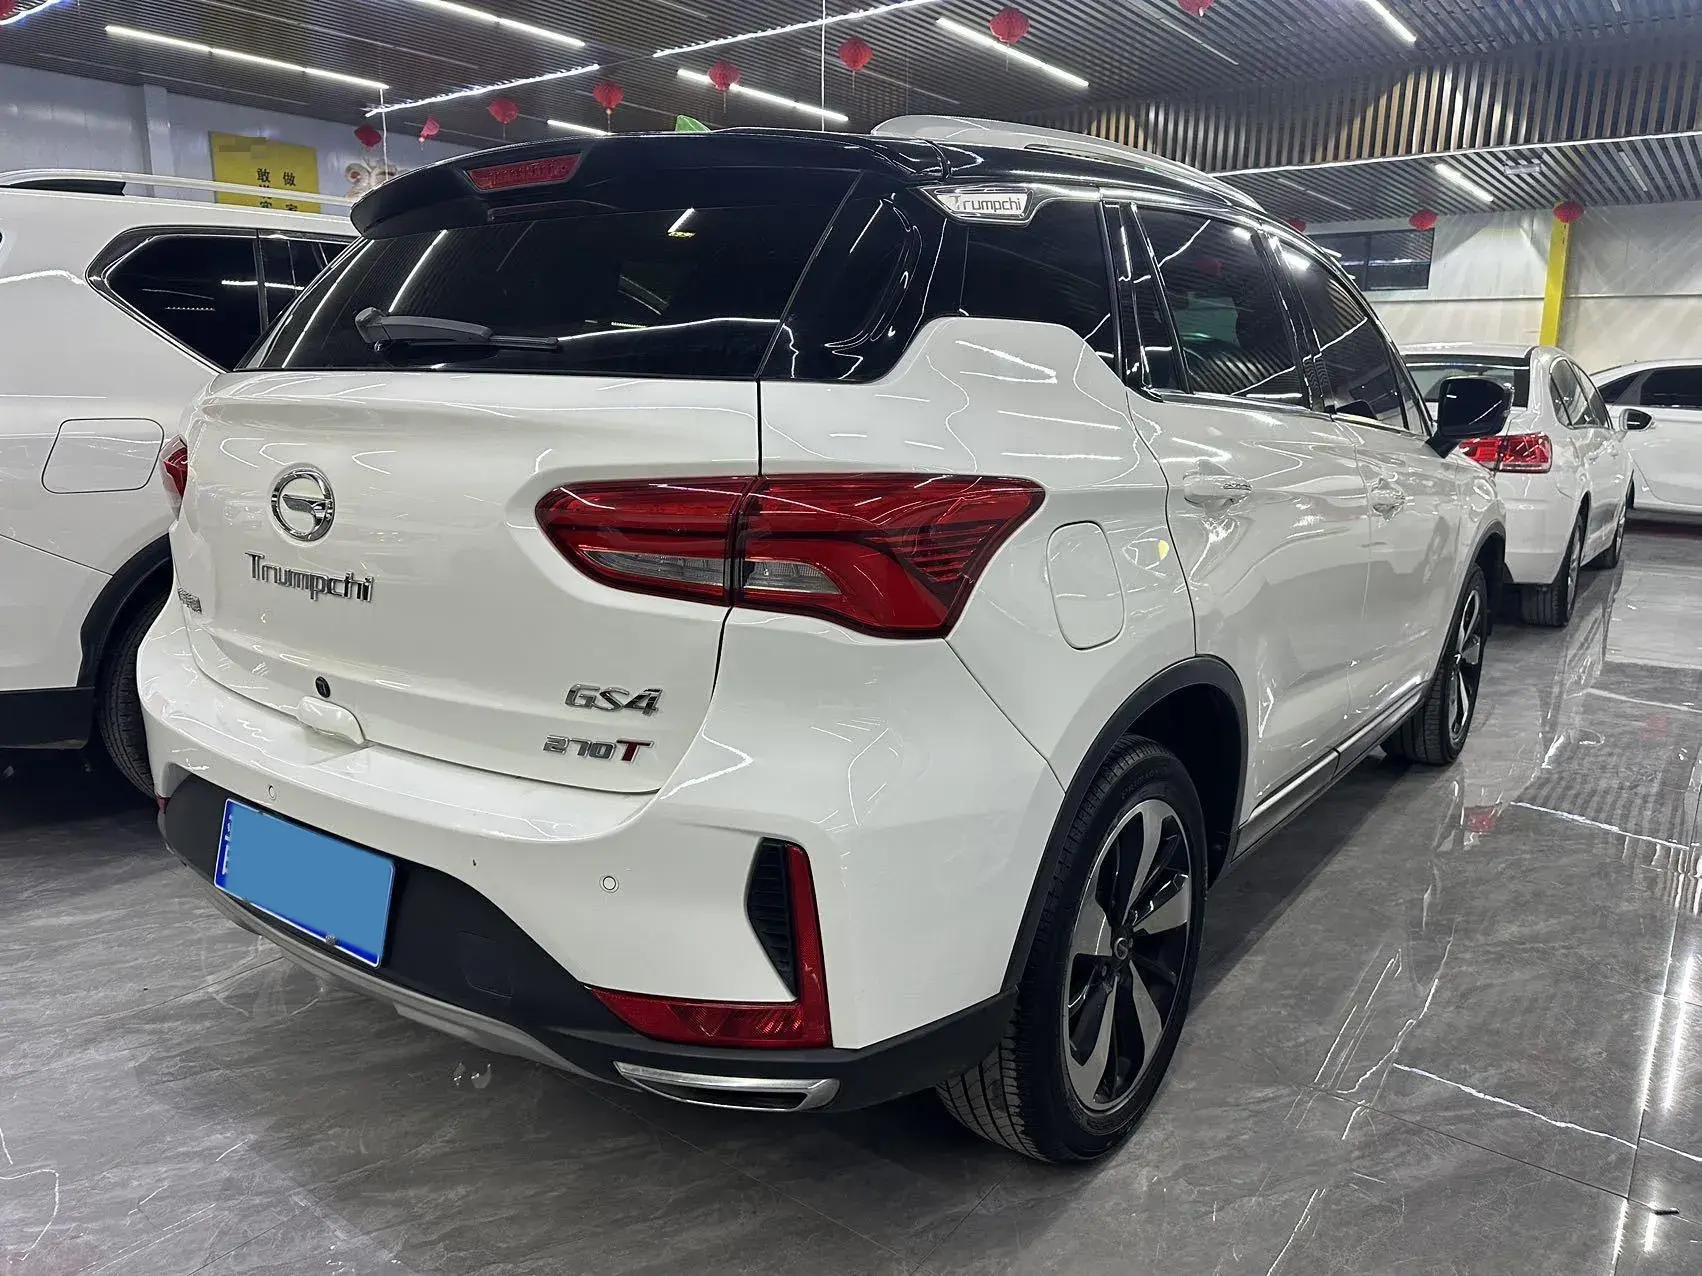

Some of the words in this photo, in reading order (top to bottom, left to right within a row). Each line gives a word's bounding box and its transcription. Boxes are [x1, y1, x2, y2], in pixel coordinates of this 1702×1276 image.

[949, 195, 1021, 212] Trumpchi
[245, 552, 374, 602] Trumpchi
[565, 683, 663, 716] GS4
[543, 734, 655, 763] 270T
